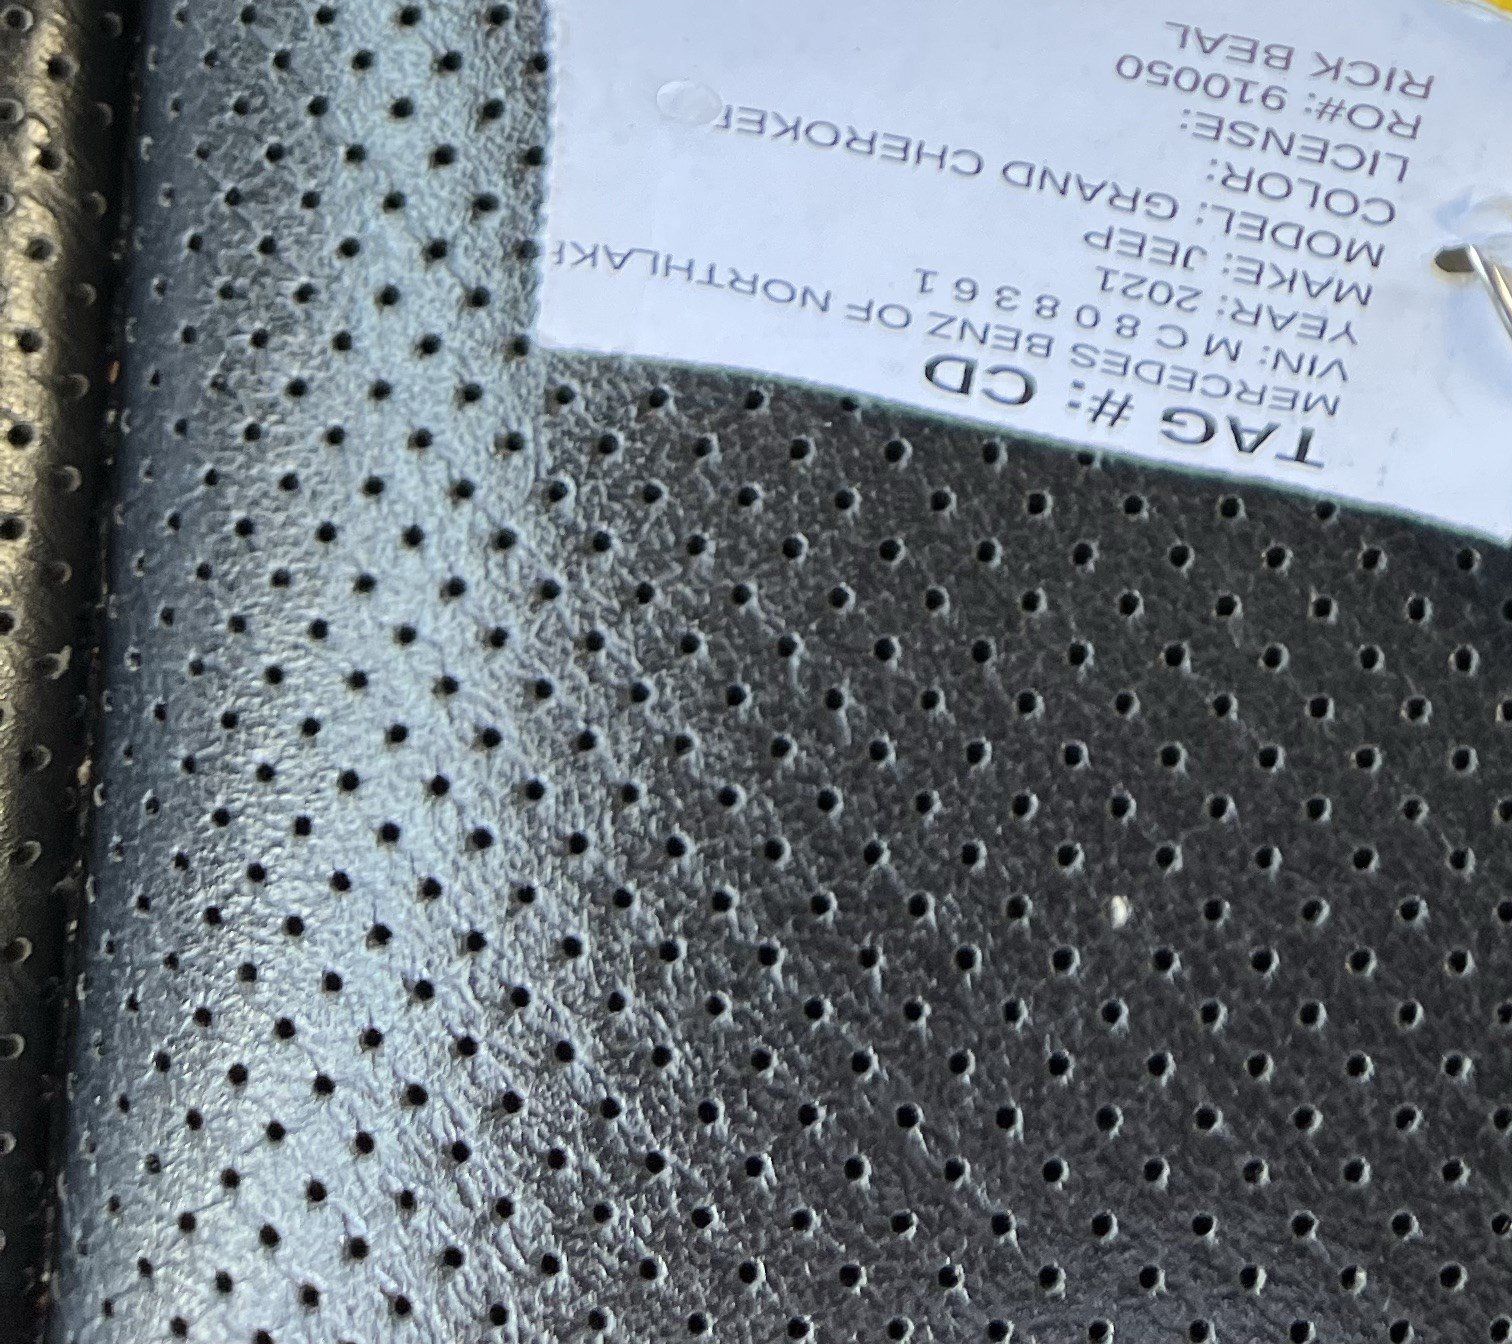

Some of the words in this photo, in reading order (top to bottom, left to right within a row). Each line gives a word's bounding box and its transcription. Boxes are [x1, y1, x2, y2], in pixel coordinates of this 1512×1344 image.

[1165, 21, 1295, 73] BEAL
[1116, 53, 1288, 112] 910050
[1312, 51, 1435, 100] RICK
[1304, 91, 1424, 141] RO#:
[1180, 108, 1411, 184] LICENSE:
[1002, 160, 1180, 222] GRAND
[1206, 157, 1397, 226] COLOR:
[1084, 225, 1207, 271] JEEP
[1195, 201, 1387, 269] MODEL:
[1096, 264, 1203, 314] 2021
[1222, 252, 1374, 308] MAKE:
[846, 298, 913, 330] OF
[927, 311, 1055, 359] BENZ
[1218, 293, 1359, 346] YEAR:
[923, 353, 1038, 408] CD
[1071, 343, 1340, 417] MERCEDES
[1261, 344, 1350, 384] VIN:
[1161, 408, 1325, 469] TAG
